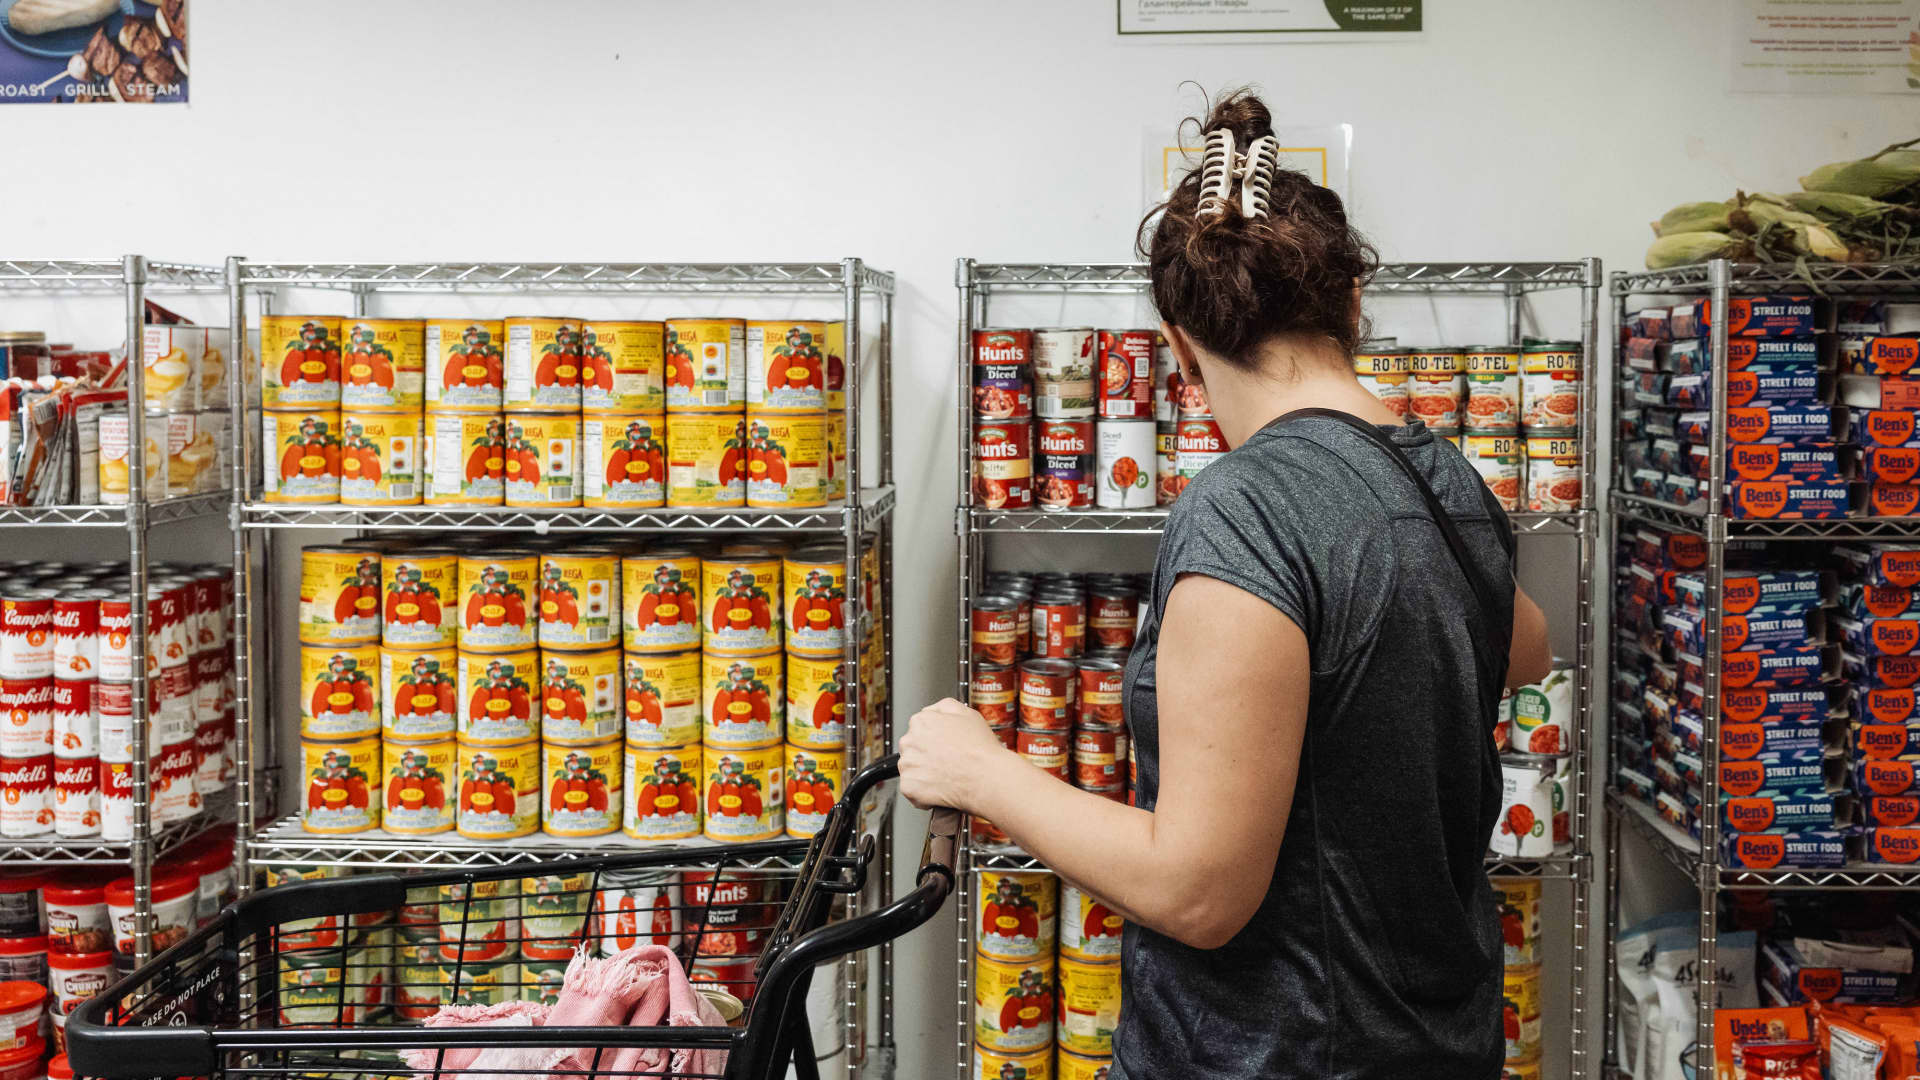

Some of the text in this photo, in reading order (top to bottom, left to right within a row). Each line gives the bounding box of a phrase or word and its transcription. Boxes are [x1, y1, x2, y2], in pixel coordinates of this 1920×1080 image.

[0, 84, 46, 97] ROAST
[126, 83, 181, 96] STEAM
[1753, 305, 1811, 315] STREET FOOD
[598, 333, 616, 344] REGA
[679, 331, 697, 342] REGA
[1759, 343, 1816, 352] STREET FOOD
[1878, 344, 1914, 358] Ben's
[987, 370, 1017, 380] Diced
[1760, 378, 1816, 388] STREET FOOD
[1728, 414, 1764, 428] Ben's
[1772, 414, 1828, 425] STREET FOOD
[1874, 417, 1909, 431] Ben's
[365, 425, 385, 437] REGA
[525, 427, 544, 438] REGA
[771, 426, 790, 438] REGA
[1738, 451, 1773, 465] Ben's
[1781, 452, 1834, 462] STREET FOOD
[1879, 454, 1914, 468] Ben's
[1048, 460, 1077, 470] Diced
[1745, 488, 1781, 503] Ben's
[1790, 489, 1846, 499] STREET FOOD
[424, 568, 443, 579] REGA
[564, 568, 583, 579] REGA
[1761, 581, 1817, 593] STREET FOOD
[1751, 619, 1804, 631] STREET FOOD
[1878, 626, 1913, 641] Ben's
[1762, 656, 1819, 668] STREET FOOD
[570, 665, 589, 676] REGA
[645, 667, 664, 678] REGA
[1725, 693, 1762, 709] Ben's
[1769, 691, 1825, 703] STREET FOOD
[1873, 694, 1909, 709] Ben's
[1723, 730, 1759, 745] Ben's
[1766, 728, 1819, 740] STREET FOOD
[1865, 730, 1901, 746] Ben's
[499, 758, 519, 769] REGA
[819, 758, 838, 769] REGA
[1723, 767, 1759, 782] Ben's
[1766, 766, 1821, 778] STREET FOOD
[1871, 768, 1907, 782] Ben's
[1733, 804, 1769, 819] Ben's
[1776, 804, 1831, 815] STREET FOOD
[1787, 842, 1843, 853] STREET FOOD
[1881, 836, 1918, 850] Ben's
[1743, 842, 1779, 857] Ben's
[709, 914, 736, 924] Diced
[65, 979, 106, 993] CHUNKY
[1844, 975, 1897, 986] STREET FOOD
[164, 998, 176, 1016] DO
[177, 984, 196, 1005] NOT
[196, 966, 221, 992] PLACE
[1730, 1018, 1768, 1036] Uncle
[1765, 1060, 1799, 1071] RICE
